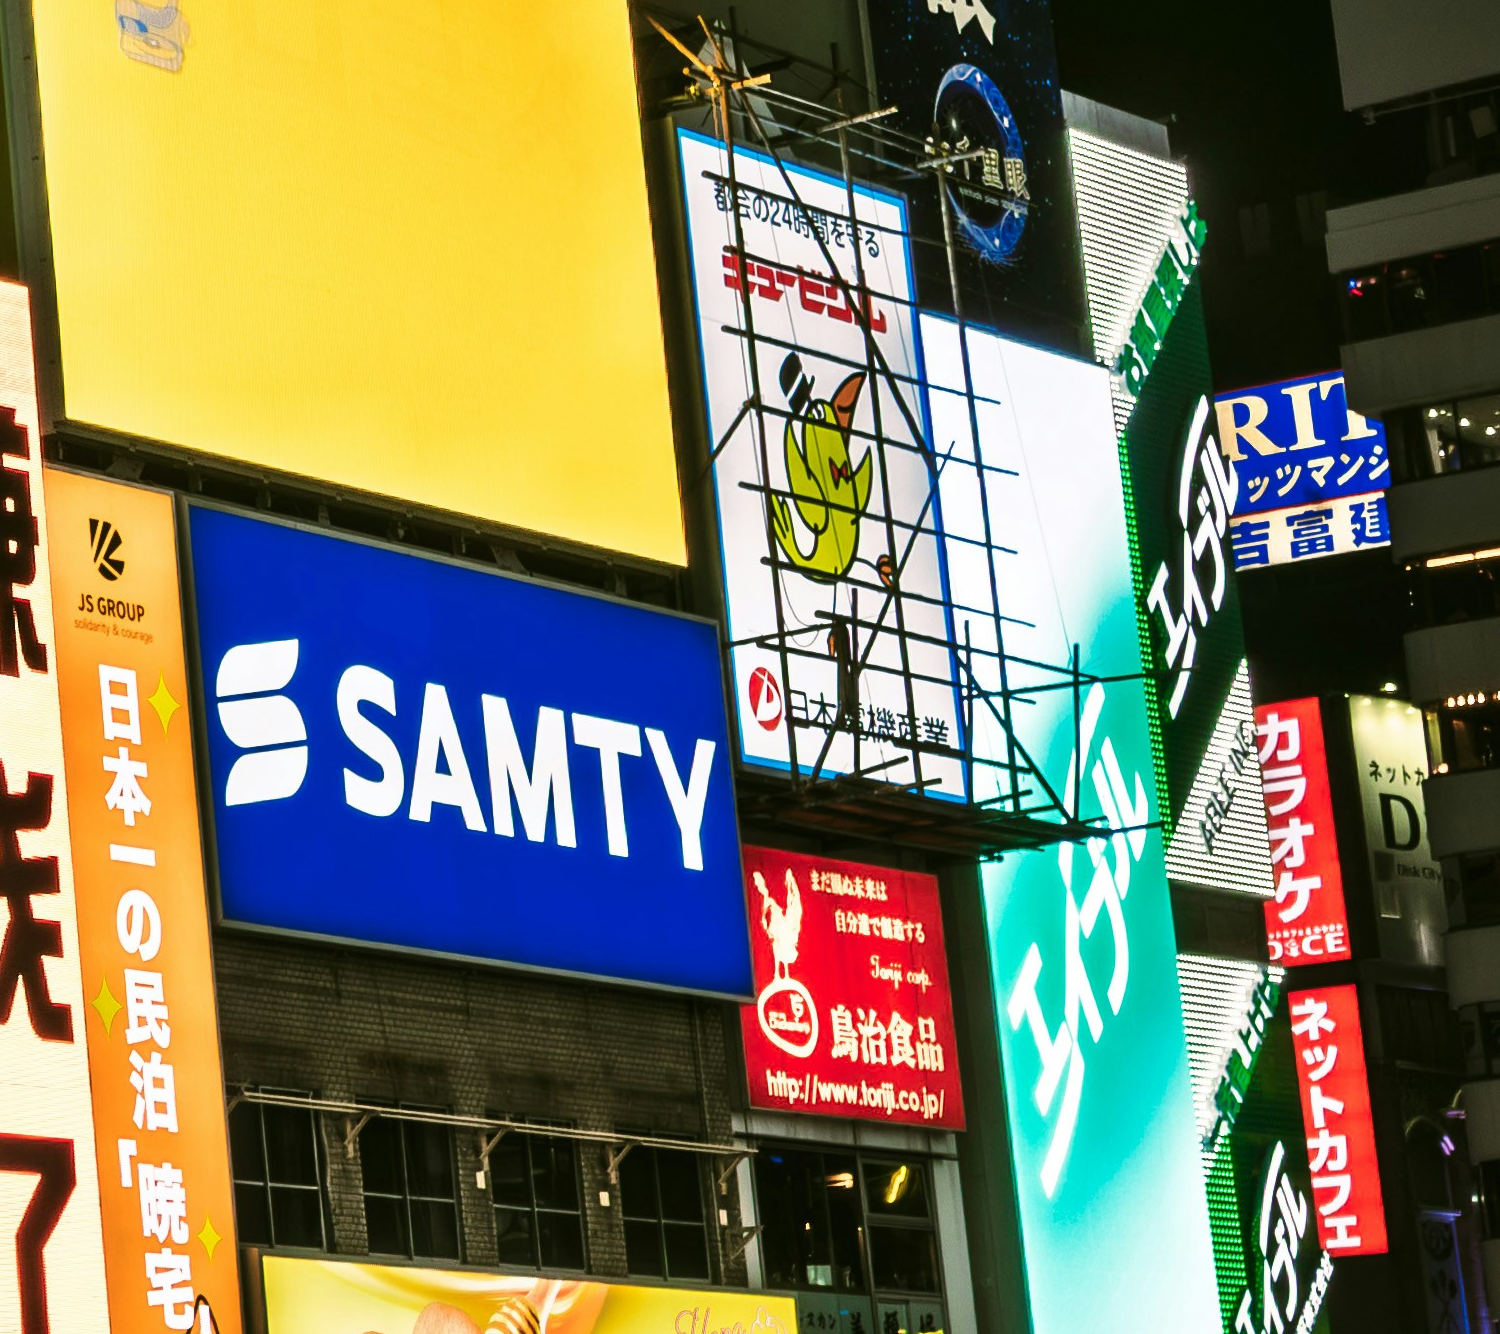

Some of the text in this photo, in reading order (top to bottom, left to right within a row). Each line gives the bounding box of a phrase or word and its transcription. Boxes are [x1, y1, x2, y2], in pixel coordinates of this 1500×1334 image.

[78, 593, 145, 623] JS GROUP
[335, 662, 718, 873] SAMTY
[1256, 712, 1323, 924] カラオケ
[765, 1069, 945, 1119] http://www.toriji.co.jp/
[1290, 998, 1363, 1250] ネットカフェ
